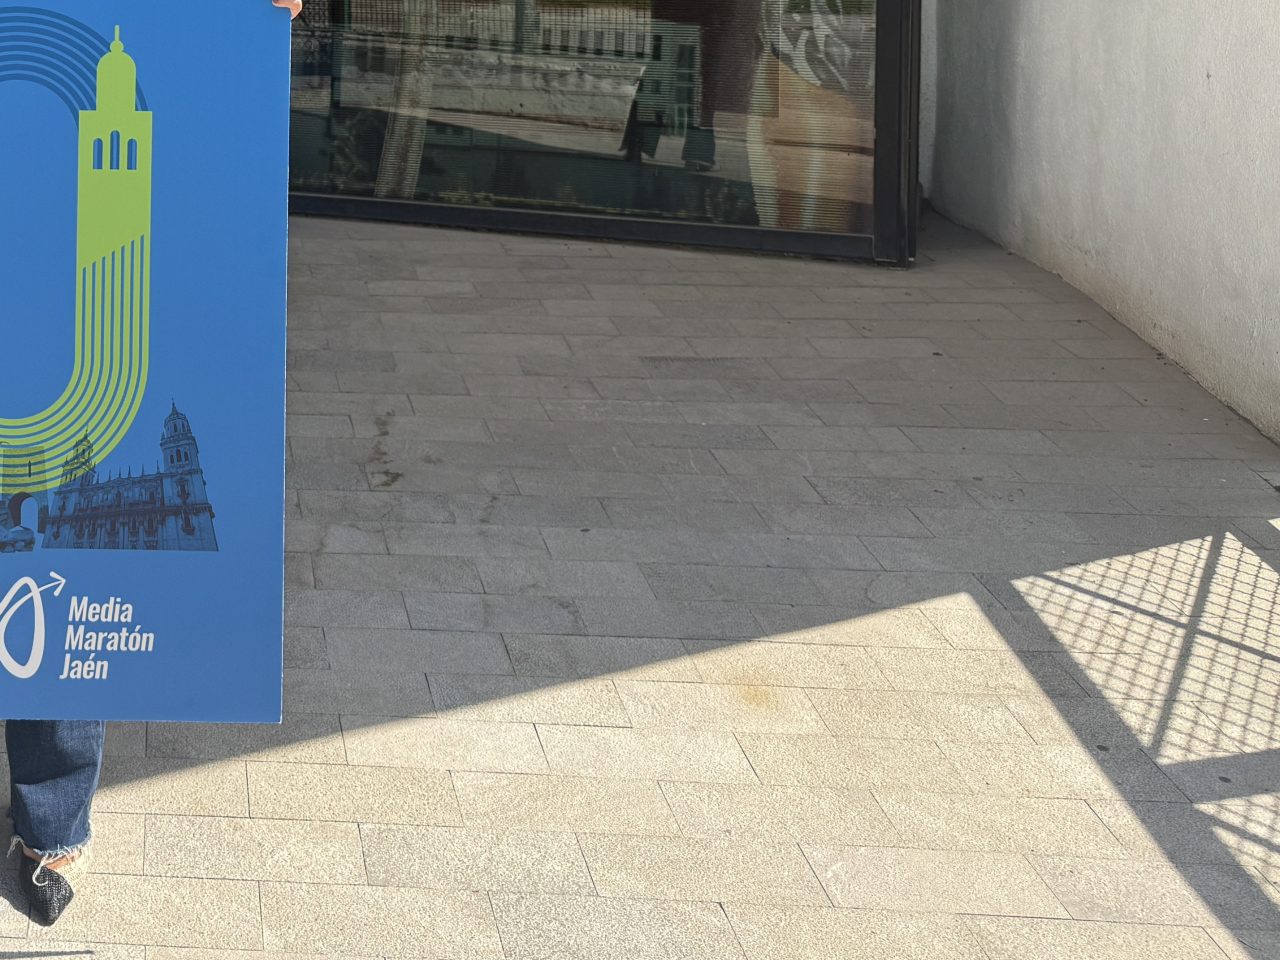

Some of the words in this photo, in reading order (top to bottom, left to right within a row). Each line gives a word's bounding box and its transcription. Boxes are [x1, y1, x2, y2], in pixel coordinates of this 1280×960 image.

[68, 596, 133, 623] Media
[64, 624, 154, 652] Maratón
[59, 652, 108, 680] Jaén
